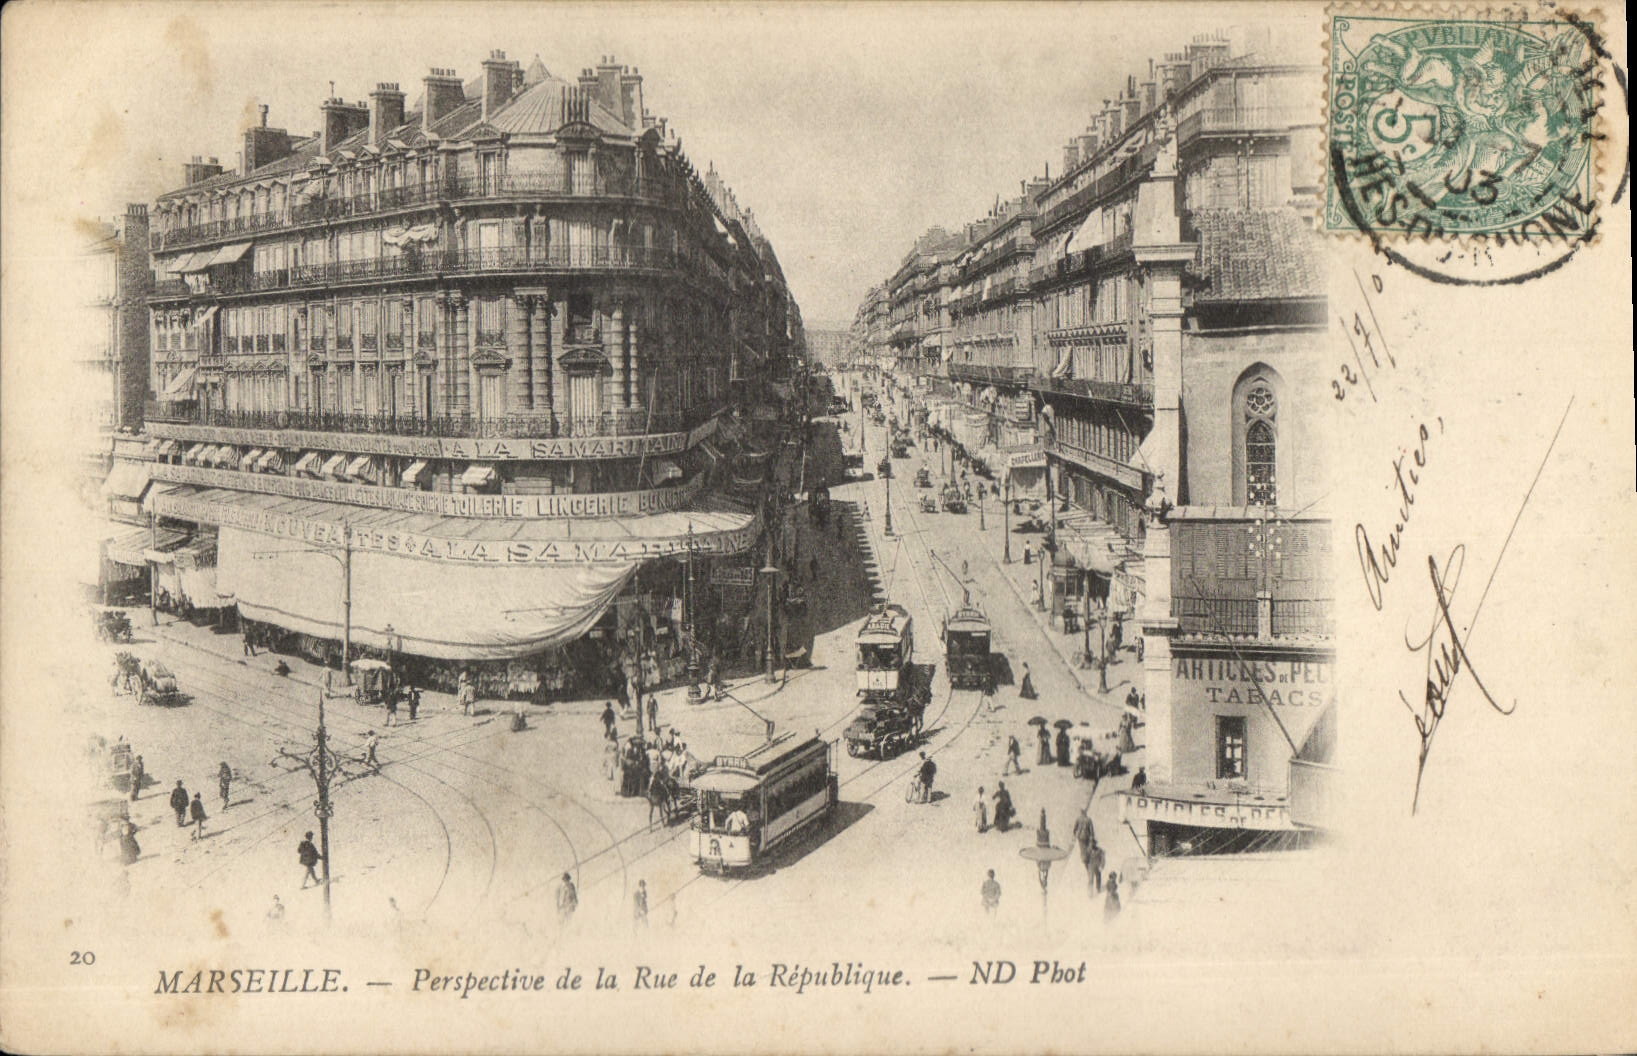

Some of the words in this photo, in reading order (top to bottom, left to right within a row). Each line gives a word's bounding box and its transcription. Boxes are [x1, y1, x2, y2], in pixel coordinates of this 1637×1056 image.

[475, 441, 518, 458] LA
[451, 495, 523, 517] TOILERIE
[536, 494, 629, 517] LINGERIE
[446, 541, 499, 562] LA
[1206, 687, 1323, 707] TABACS
